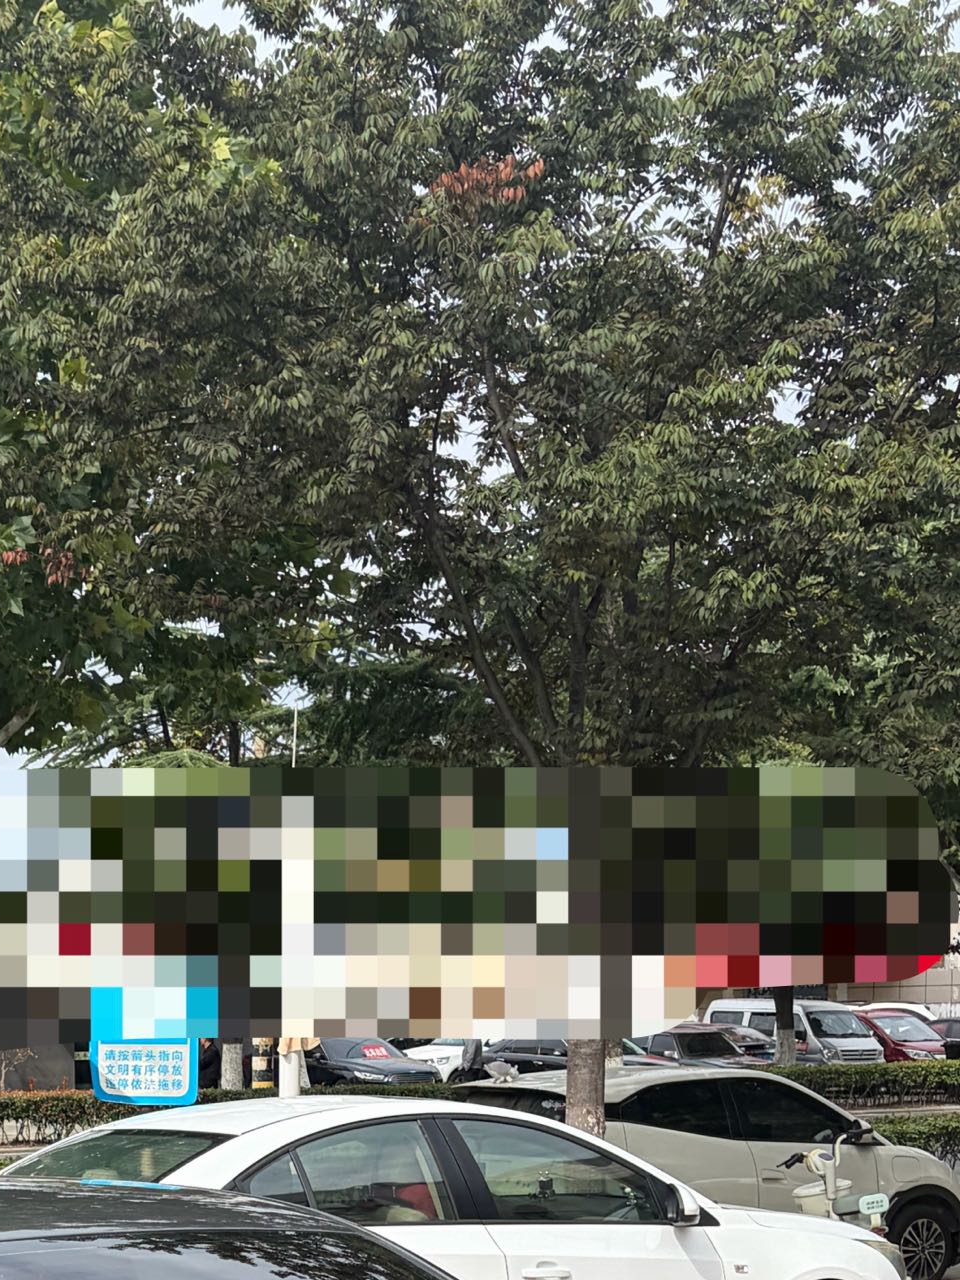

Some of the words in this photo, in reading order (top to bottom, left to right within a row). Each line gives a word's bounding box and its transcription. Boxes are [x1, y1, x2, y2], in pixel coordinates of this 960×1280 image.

[104, 1050, 183, 1061] 请按箭头指向
[105, 1064, 183, 1076] 文明有序停放
